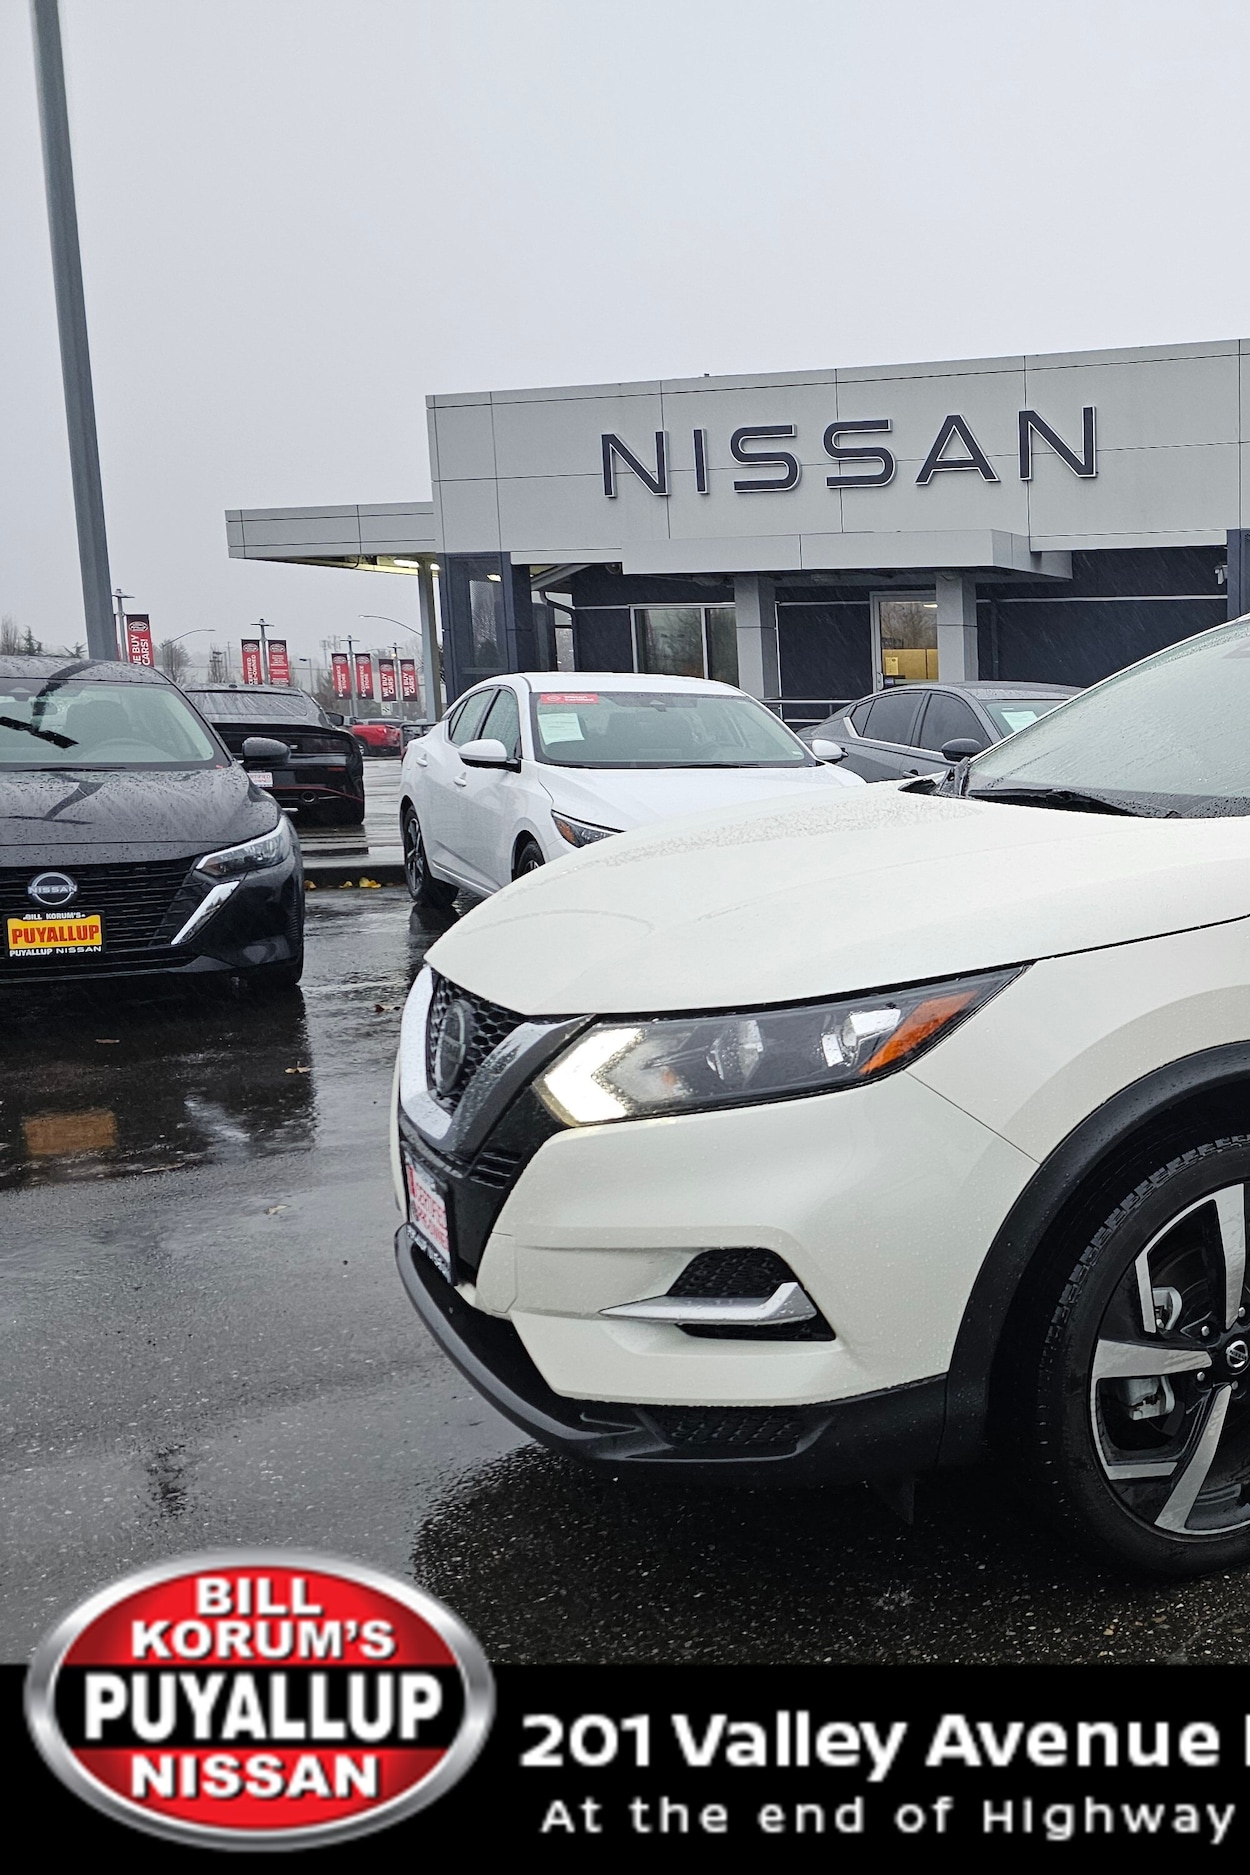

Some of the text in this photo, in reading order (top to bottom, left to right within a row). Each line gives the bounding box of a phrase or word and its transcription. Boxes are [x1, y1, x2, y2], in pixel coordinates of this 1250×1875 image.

[601, 406, 1097, 498] NISSAN
[130, 634, 141, 653] BUY
[140, 639, 150, 665] CARS!
[382, 686, 389, 697] WE
[387, 676, 395, 694] CARS!
[404, 686, 411, 697] WE
[28, 885, 77, 894] NISSAN
[12, 925, 99, 944] PUYALLUP
[10, 946, 102, 957] PUYALLUP NISSAN
